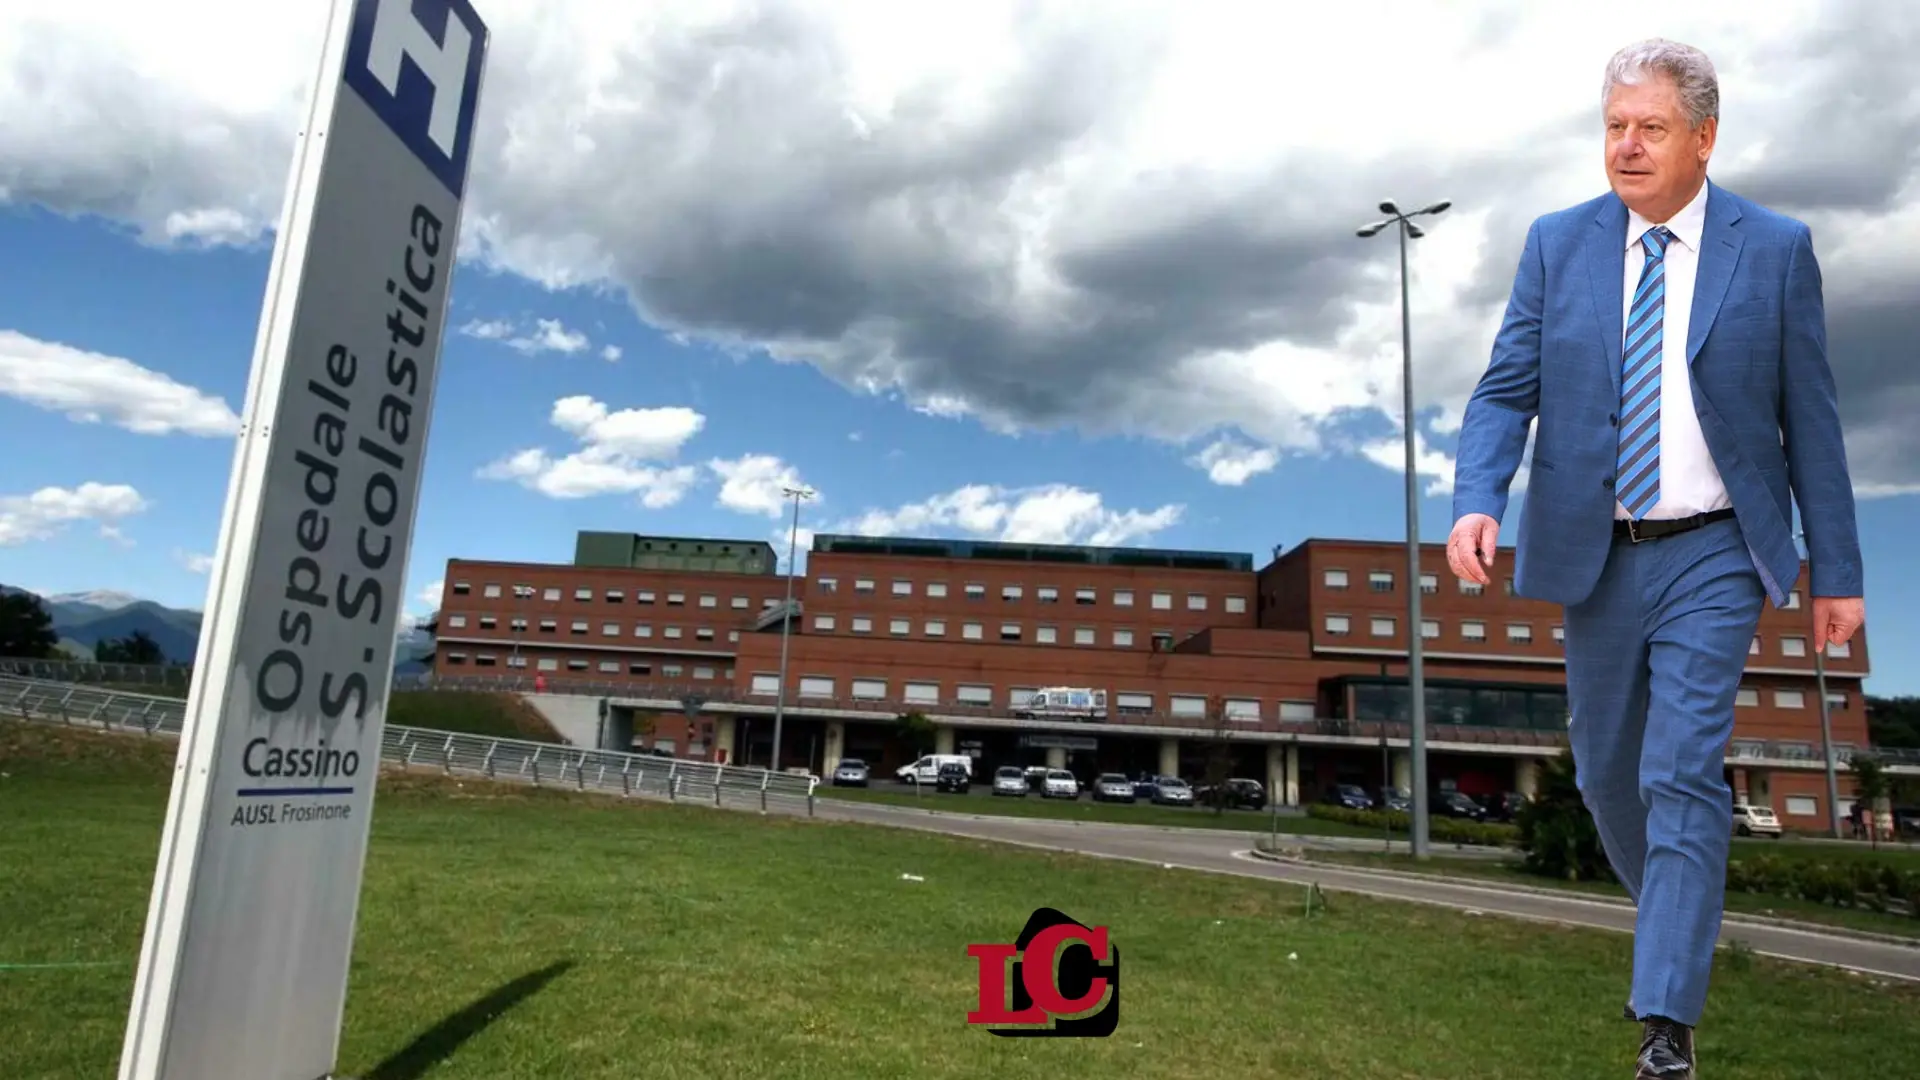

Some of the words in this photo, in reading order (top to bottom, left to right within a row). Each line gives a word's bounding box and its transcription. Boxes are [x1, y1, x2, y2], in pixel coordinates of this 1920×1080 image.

[337, 203, 443, 624] Scolastica
[257, 344, 357, 712] Ospedale
[320, 648, 374, 719] S.
[243, 737, 359, 777] Cassino
[230, 804, 276, 826] AUSL
[280, 803, 351, 823] Frosinone
